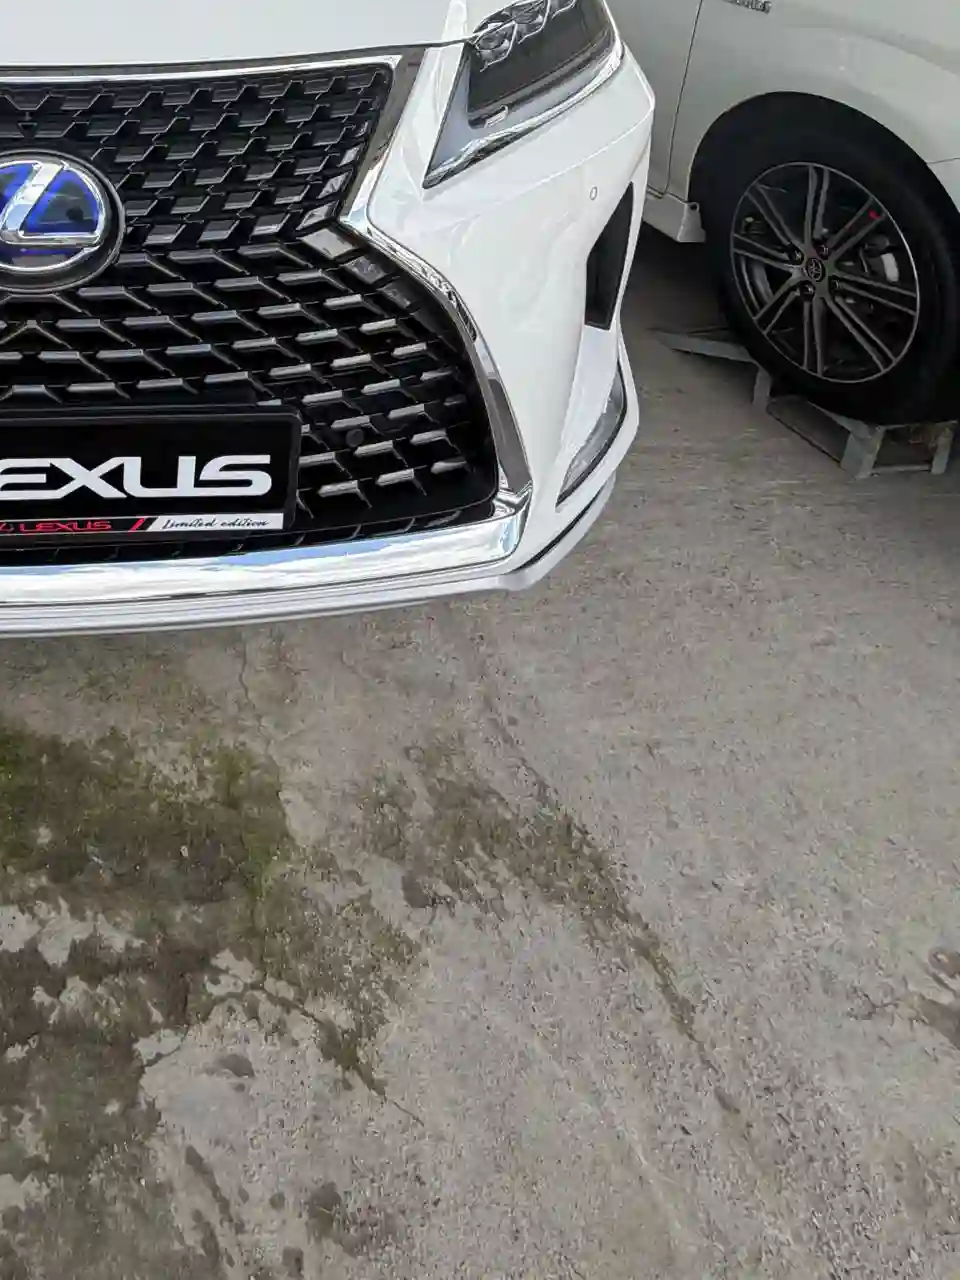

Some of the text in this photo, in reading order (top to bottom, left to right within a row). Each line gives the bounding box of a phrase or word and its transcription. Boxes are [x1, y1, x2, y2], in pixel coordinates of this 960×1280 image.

[19, 521, 113, 534] LEXUS
[162, 519, 270, 531] Limited edition
